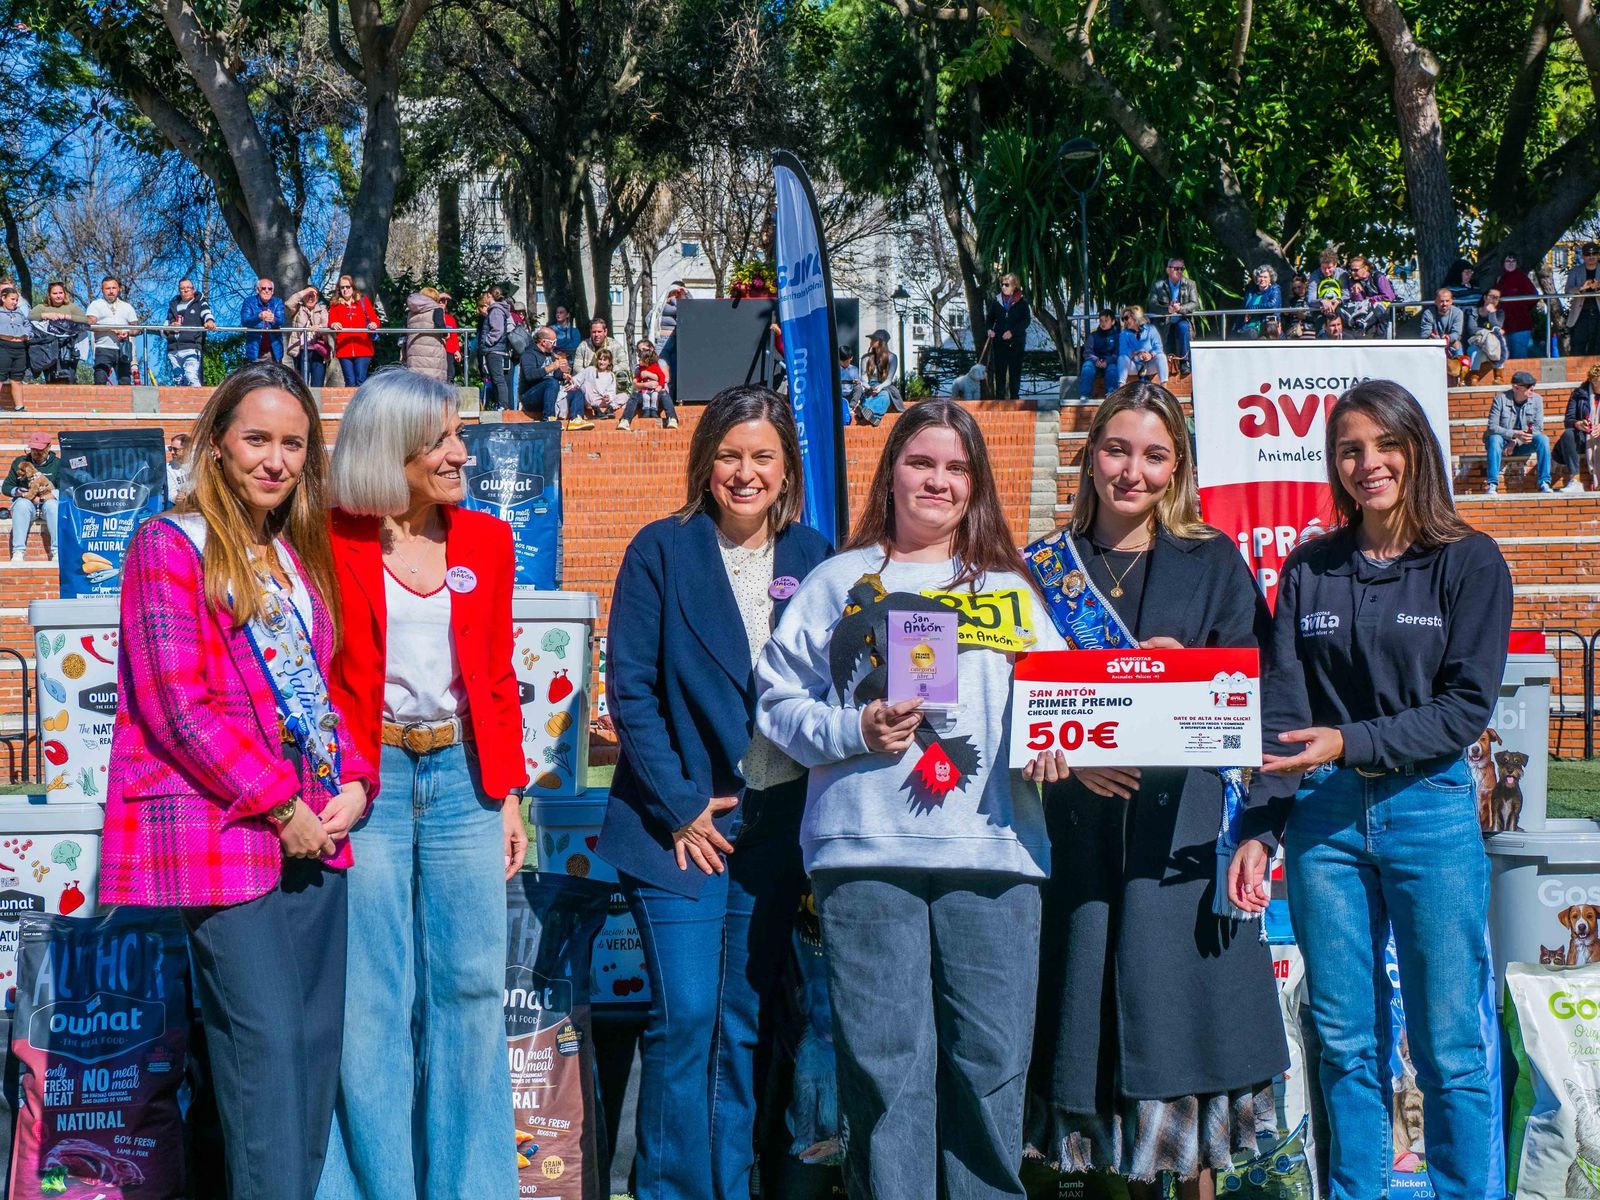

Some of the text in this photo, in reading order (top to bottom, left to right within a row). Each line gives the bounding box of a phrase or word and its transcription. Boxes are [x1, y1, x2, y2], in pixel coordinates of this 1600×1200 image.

[1258, 446, 1323, 462] Animales
[480, 478, 533, 492] ownat
[84, 486, 137, 501] ownat
[82, 523, 99, 532] FRESH
[102, 518, 118, 530] NO
[87, 541, 126, 551] NATURAL
[912, 613, 930, 624] San
[1396, 613, 1443, 628] Seresto
[903, 621, 943, 634] Antón
[958, 630, 1014, 646] an Antón
[1029, 688, 1096, 698] SAN ANTÓN
[1028, 697, 1133, 708] PRIMER PREMIO
[79, 723, 91, 734] The
[1026, 720, 1119, 751] 50€
[1548, 991, 1600, 1020] Go
[50, 1007, 143, 1036] ownat
[519, 1016, 538, 1024] FOOD
[527, 1046, 553, 1060] meat
[44, 1063, 67, 1081] only
[112, 1063, 139, 1079] meat
[526, 1060, 554, 1072] meal
[43, 1079, 74, 1093] FRESH
[82, 1068, 110, 1092] NO
[111, 1078, 140, 1090] meal
[43, 1091, 74, 1107] MEAT
[57, 1110, 126, 1132] NATURAL
[528, 1115, 571, 1129] 60% FRESH
[113, 1134, 156, 1148] 60% FRESH
[543, 1160, 562, 1169] GRAIN
[1059, 1181, 1085, 1189] Lamb
[1390, 1179, 1427, 1188] Chicken
